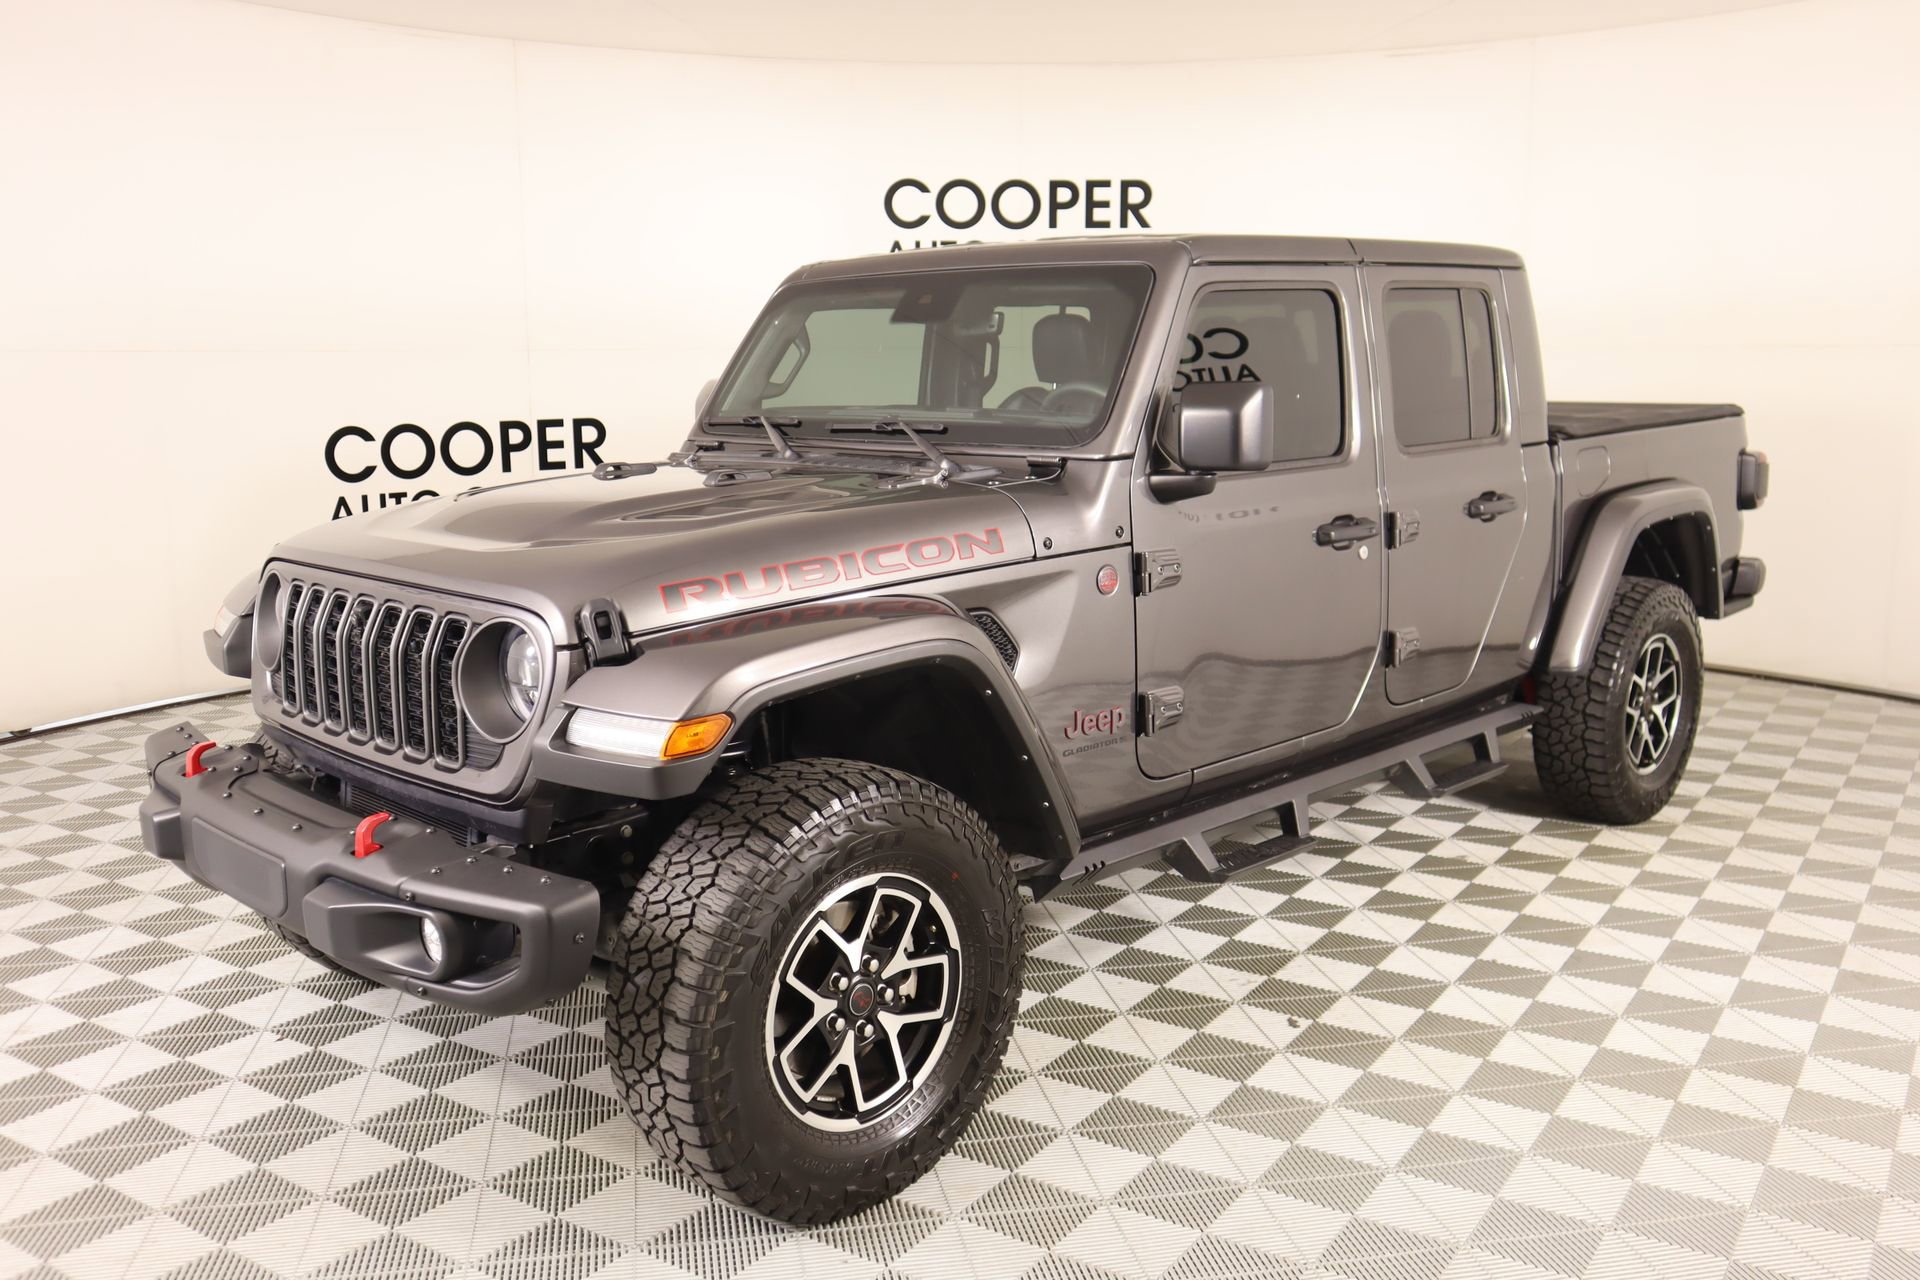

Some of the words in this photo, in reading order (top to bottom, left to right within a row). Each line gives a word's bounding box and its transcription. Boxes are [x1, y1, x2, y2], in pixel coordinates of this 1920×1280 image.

[883, 178, 1153, 229] COOPER
[324, 418, 607, 483] COOPER
[658, 527, 1005, 614] RUBICON
[1062, 737, 1119, 757] GLADIATOR
[1064, 706, 1126, 740] Jeep
